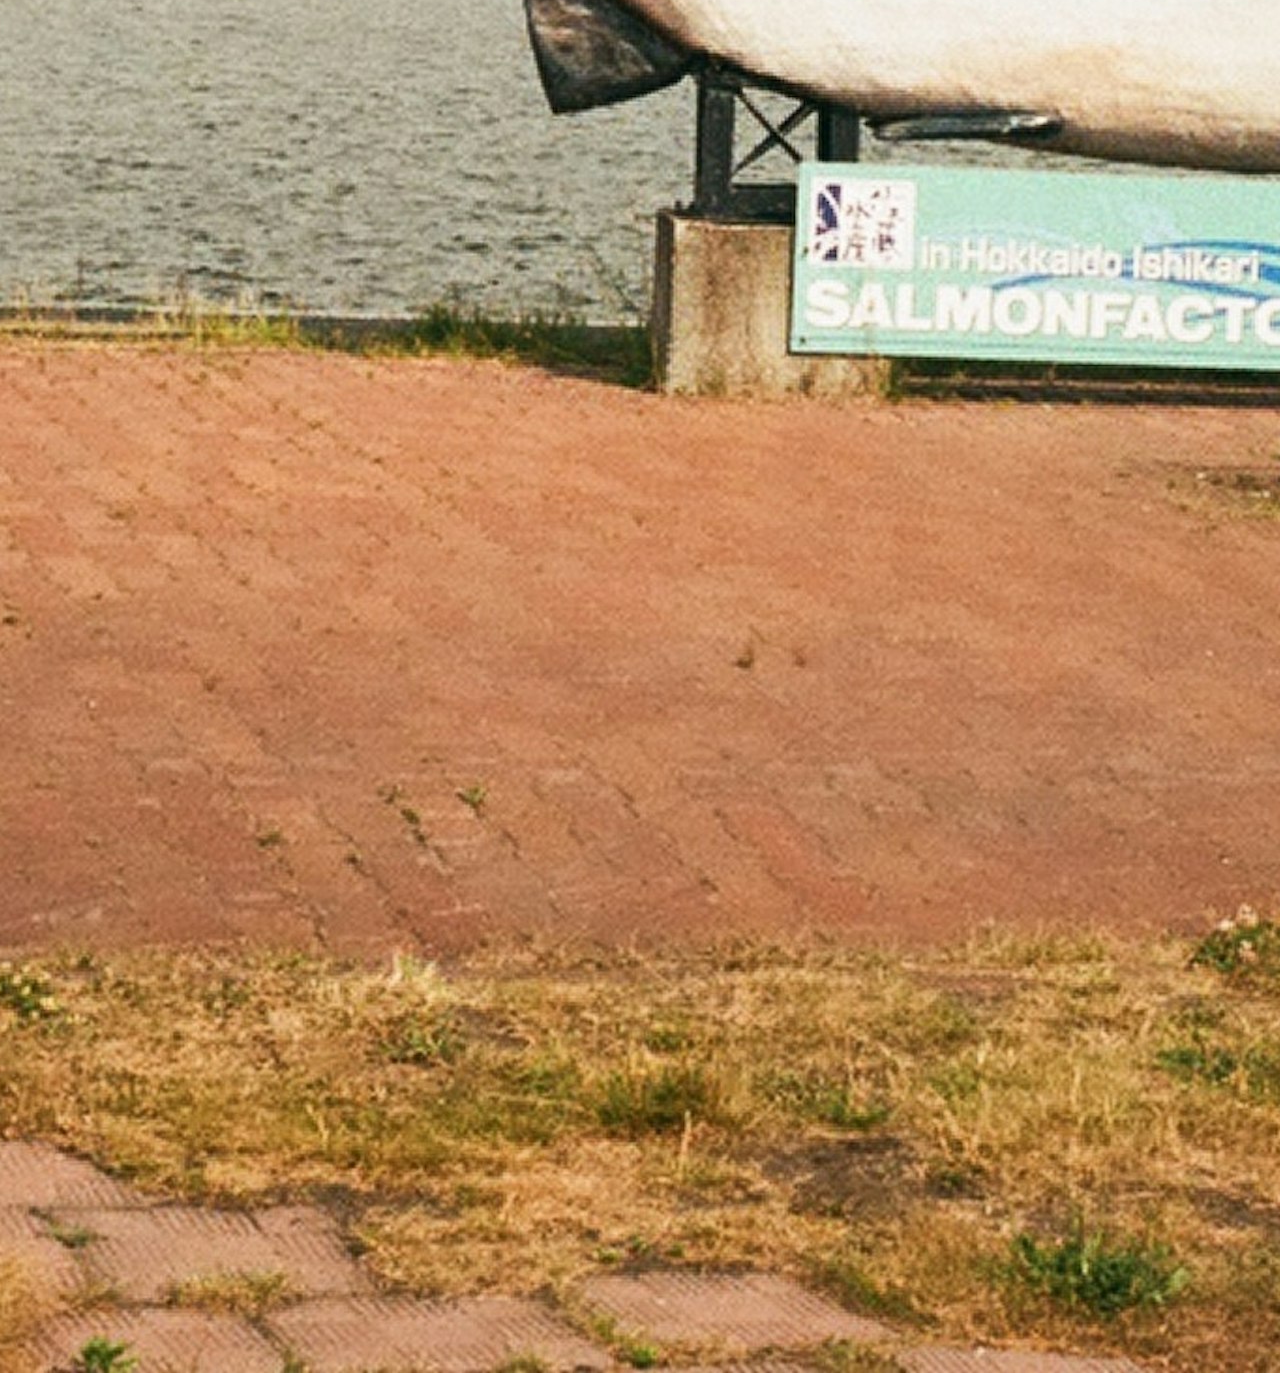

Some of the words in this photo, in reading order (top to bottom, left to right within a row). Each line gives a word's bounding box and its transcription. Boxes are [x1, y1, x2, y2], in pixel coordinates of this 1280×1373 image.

[923, 237, 950, 270] in
[961, 239, 1123, 277] Hokkaido
[1132, 245, 1260, 282] Ishikari
